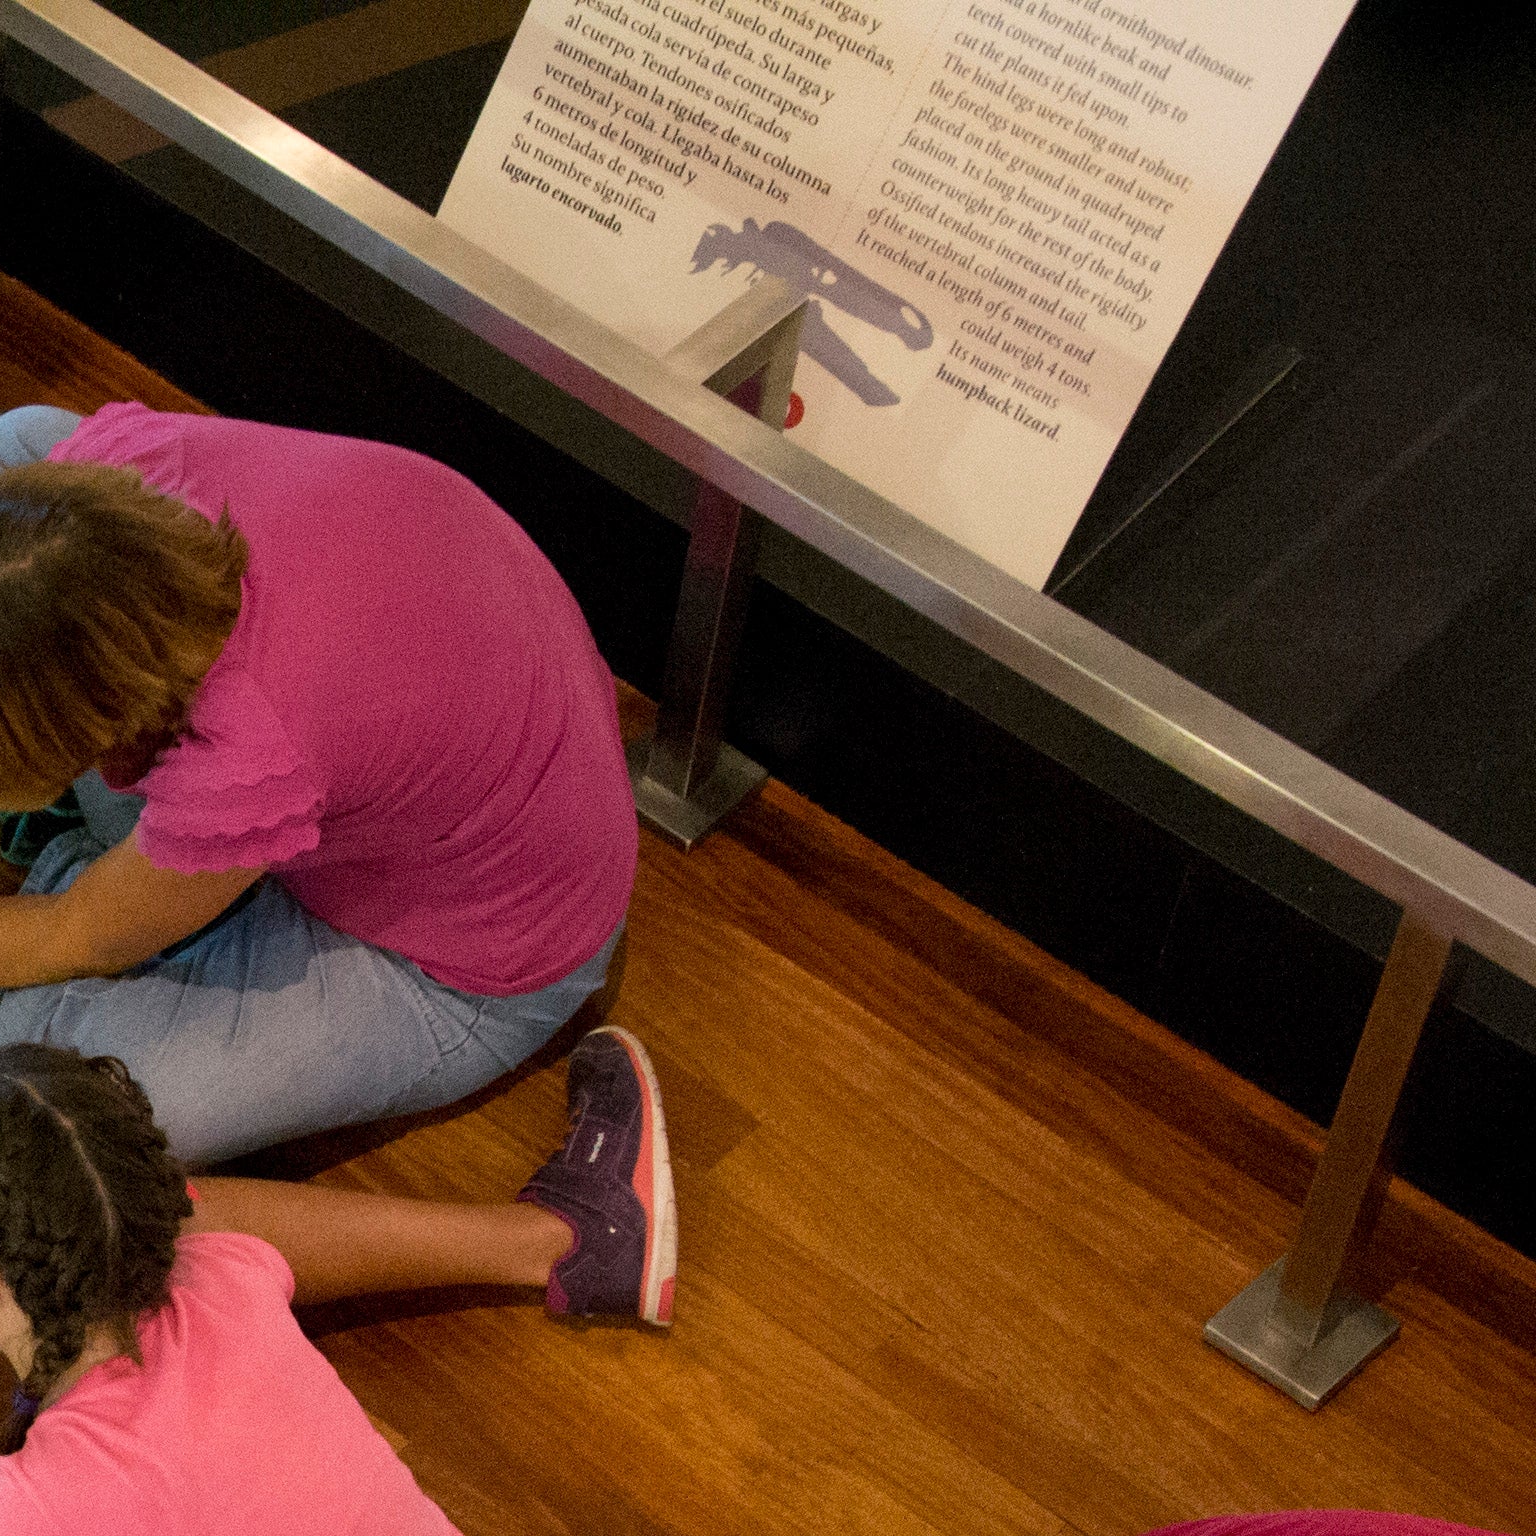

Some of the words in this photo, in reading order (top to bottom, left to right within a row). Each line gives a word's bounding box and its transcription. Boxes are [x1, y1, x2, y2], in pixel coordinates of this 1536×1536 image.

[630, 19, 661, 44] cola
[662, 36, 710, 70] servía
[711, 59, 732, 81] de
[732, 73, 819, 126] contrapeso
[662, 6, 755, 63] cuadrúpeda.
[757, 52, 780, 76] Su
[780, 62, 821, 98] larga
[723, 8, 767, 36] suelo
[767, 26, 831, 70] durante
[780, 6, 816, 31] más
[813, 22, 894, 75] pequeñas,
[953, 31, 979, 50] cut
[978, 40, 1004, 63] the
[1000, 54, 1050, 87] plants
[1059, 82, 1091, 107] fed
[967, 5, 1004, 32] teeth
[1005, 24, 1064, 61] covered
[1062, 52, 1097, 78] with
[1096, 71, 1143, 100] small
[1140, 90, 1170, 114] tips
[1170, 105, 1188, 123] to
[1037, 7, 1101, 46] hornlike
[1100, 34, 1137, 66] beak
[1137, 58, 1172, 81] and
[1100, 6, 1187, 55] ornithopod
[532, 85, 545, 101] 6
[543, 93, 598, 131] metros
[598, 121, 619, 142] de
[618, 129, 687, 178] longitud
[544, 62, 614, 108] vertebral
[660, 122, 721, 167] Llegaba
[721, 154, 764, 191] hasta
[764, 177, 790, 204] los
[552, 38, 648, 98] aumentaban
[649, 86, 665, 107] la
[665, 98, 719, 137] rigidez
[720, 126, 741, 147] de
[740, 140, 761, 158] su
[761, 151, 831, 196] columna
[640, 49, 713, 101] Tendones
[713, 94, 791, 143] osificados
[942, 51, 971, 78] The
[1005, 83, 1035, 113] legs
[1035, 104, 1073, 130] were
[1073, 118, 1107, 152] long
[1107, 141, 1140, 164] and
[500, 154, 551, 194] lagarto
[510, 132, 532, 154] Su
[532, 146, 592, 187] nombre
[591, 179, 656, 223] significa
[522, 109, 534, 125] 4
[533, 117, 606, 165] toneladas
[606, 155, 626, 176] de
[624, 169, 664, 199] peso.
[898, 128, 958, 170] fashion.
[961, 158, 982, 180] Its
[982, 167, 1016, 202] long
[1015, 185, 1062, 223] heavy
[1061, 212, 1091, 236] tail
[1088, 229, 1132, 257] acted
[913, 106, 966, 139] placed
[963, 131, 983, 150] on
[984, 139, 1009, 162] the
[1005, 155, 1066, 191] ground
[1080, 193, 1165, 241] quadruped
[928, 79, 953, 102] the
[949, 90, 1009, 132] forelegs
[1009, 122, 1047, 149] were
[1047, 142, 1105, 178] smaller
[1103, 172, 1137, 194] and
[1135, 186, 1174, 214] were
[880, 179, 940, 220] Ossified
[937, 211, 995, 250] tendons
[995, 239, 1067, 287] increased
[1064, 277, 1090, 299] the
[1089, 292, 1147, 331] rigidity
[883, 213, 907, 235] the
[907, 228, 975, 271] vertebral
[973, 264, 1027, 299] column
[1028, 292, 1060, 315] and
[1057, 306, 1087, 331] tail.
[891, 158, 994, 217] counterweight
[989, 206, 1017, 228] for
[1017, 220, 1042, 243] the
[1041, 235, 1072, 258] rest
[1071, 251, 1093, 270] of
[1088, 257, 1113, 279] the
[1113, 267, 1152, 302] body.
[855, 227, 870, 247] It
[869, 238, 928, 276] reached
[936, 269, 983, 307] length
[1000, 306, 1014, 322] 6
[1012, 315, 1063, 349] metres
[1062, 343, 1096, 365] and
[935, 361, 1013, 416] humpback
[1012, 403, 1061, 442] lizard.
[948, 338, 969, 361] Its
[968, 354, 1011, 382] name
[1010, 376, 1059, 408] means
[959, 319, 1003, 347] could
[1046, 361, 1058, 377] 4
[1057, 368, 1090, 397] tons.
